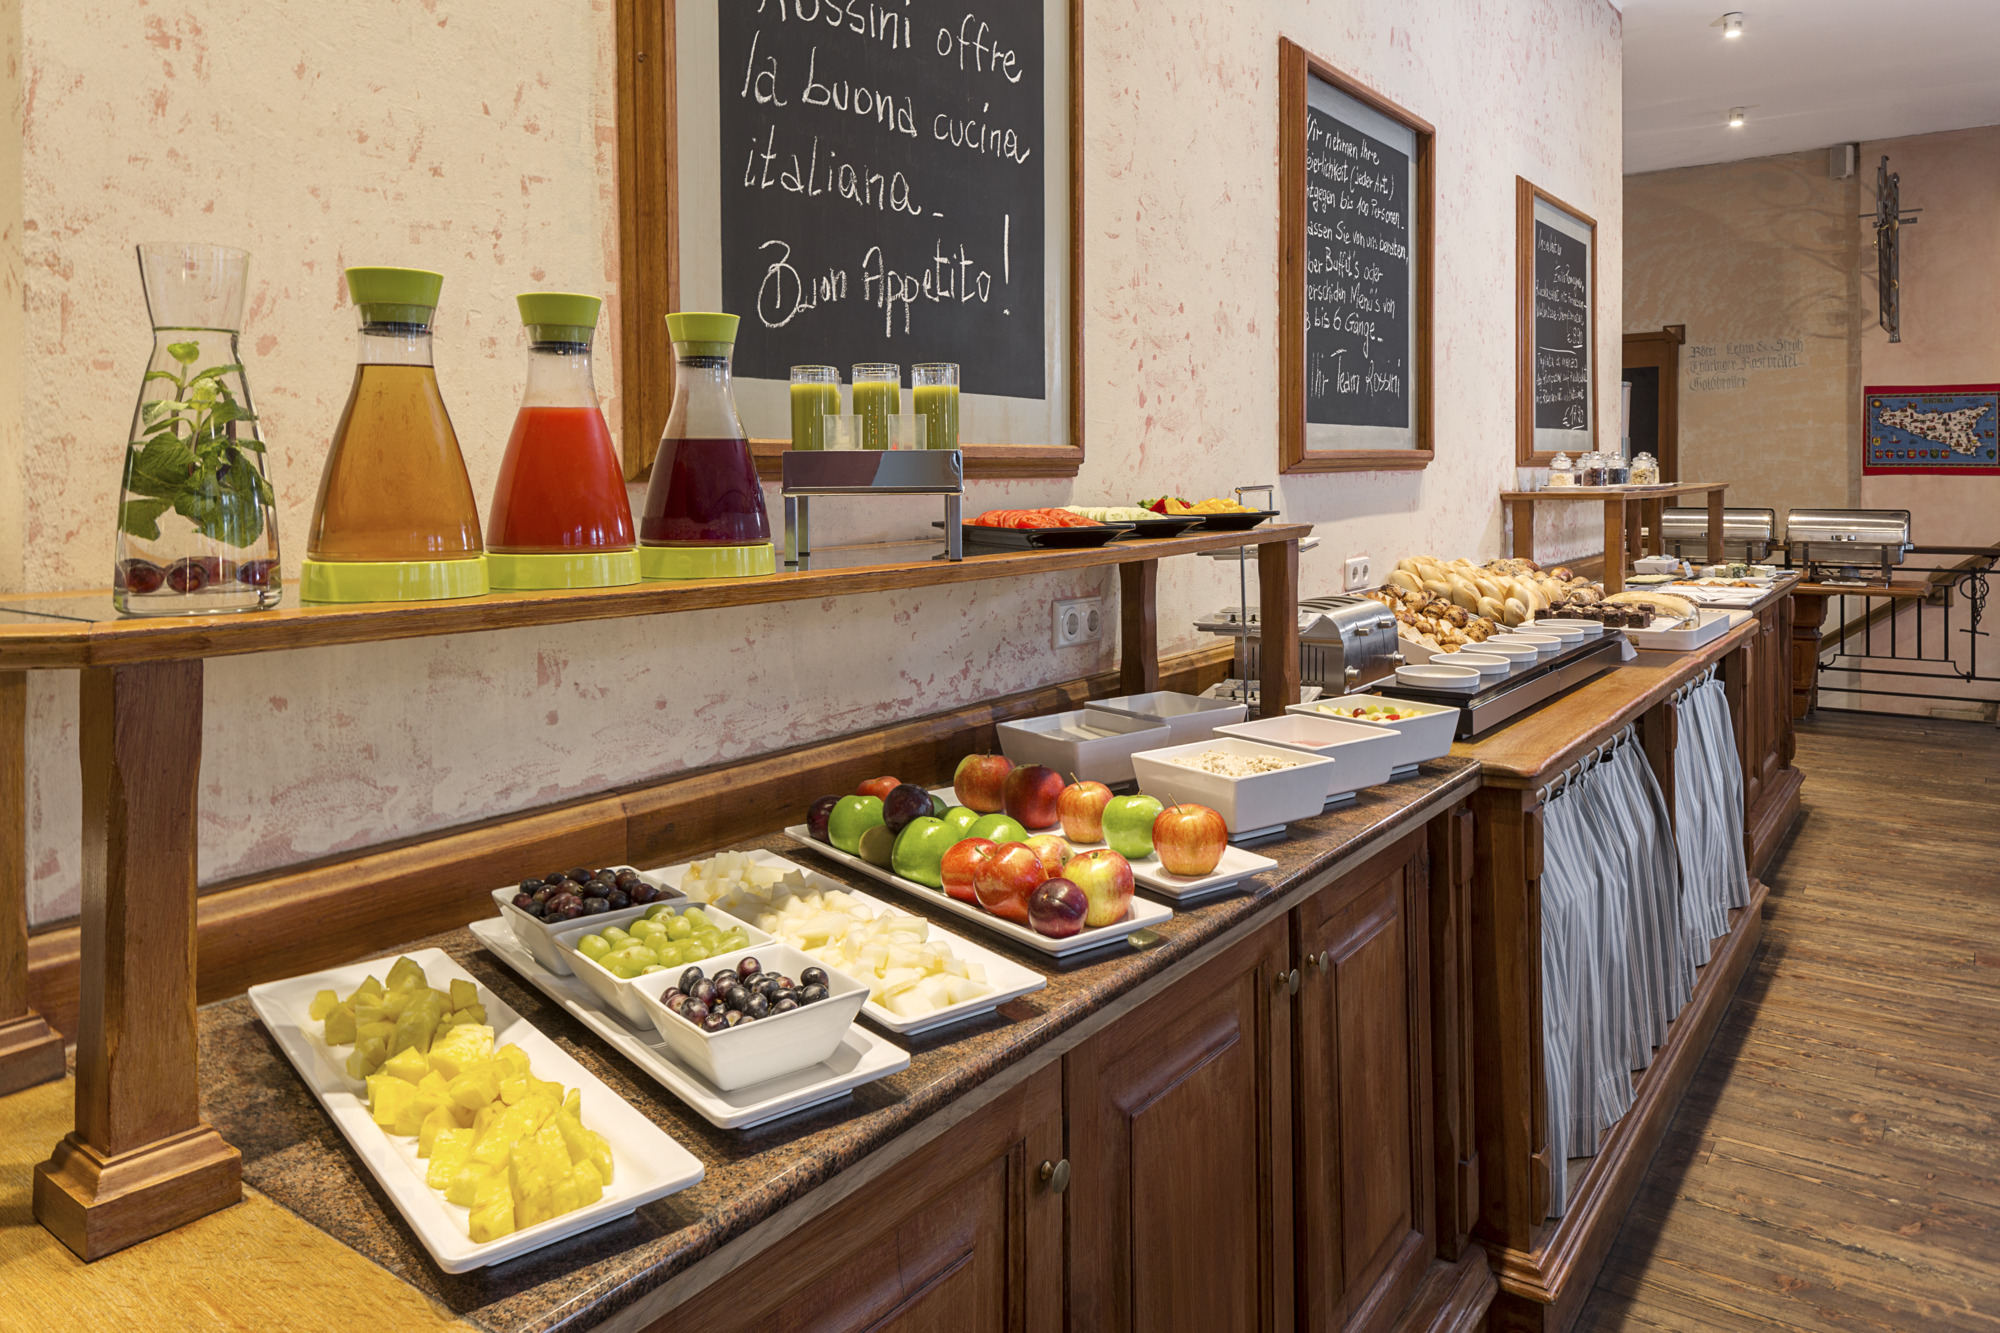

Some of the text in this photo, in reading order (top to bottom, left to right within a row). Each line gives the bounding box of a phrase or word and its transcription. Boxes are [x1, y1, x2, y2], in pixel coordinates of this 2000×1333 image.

[937, 13, 1023, 83] offre
[741, 30, 1030, 164] la buona cucina
[1326, 130, 1358, 160] nehmen
[1360, 138, 1380, 165] Ihre
[1339, 190, 1354, 210] bis
[1307, 220, 1333, 241] assen
[1335, 220, 1351, 244] Sie
[1352, 230, 1366, 249] von
[1366, 236, 1378, 250] uns
[757, 240, 847, 328] Buon
[1307, 250, 1324, 274] ber
[1363, 262, 1384, 284] oder
[1314, 307, 1331, 329] bis
[1333, 306, 1342, 331] 6
[1383, 298, 1396, 320] von
[1726, 341, 1755, 356] Lehm
[1756, 340, 1770, 353] &
[1770, 337, 1804, 354] Stroh
[1310, 348, 1401, 399] Ihr Team Rossini
